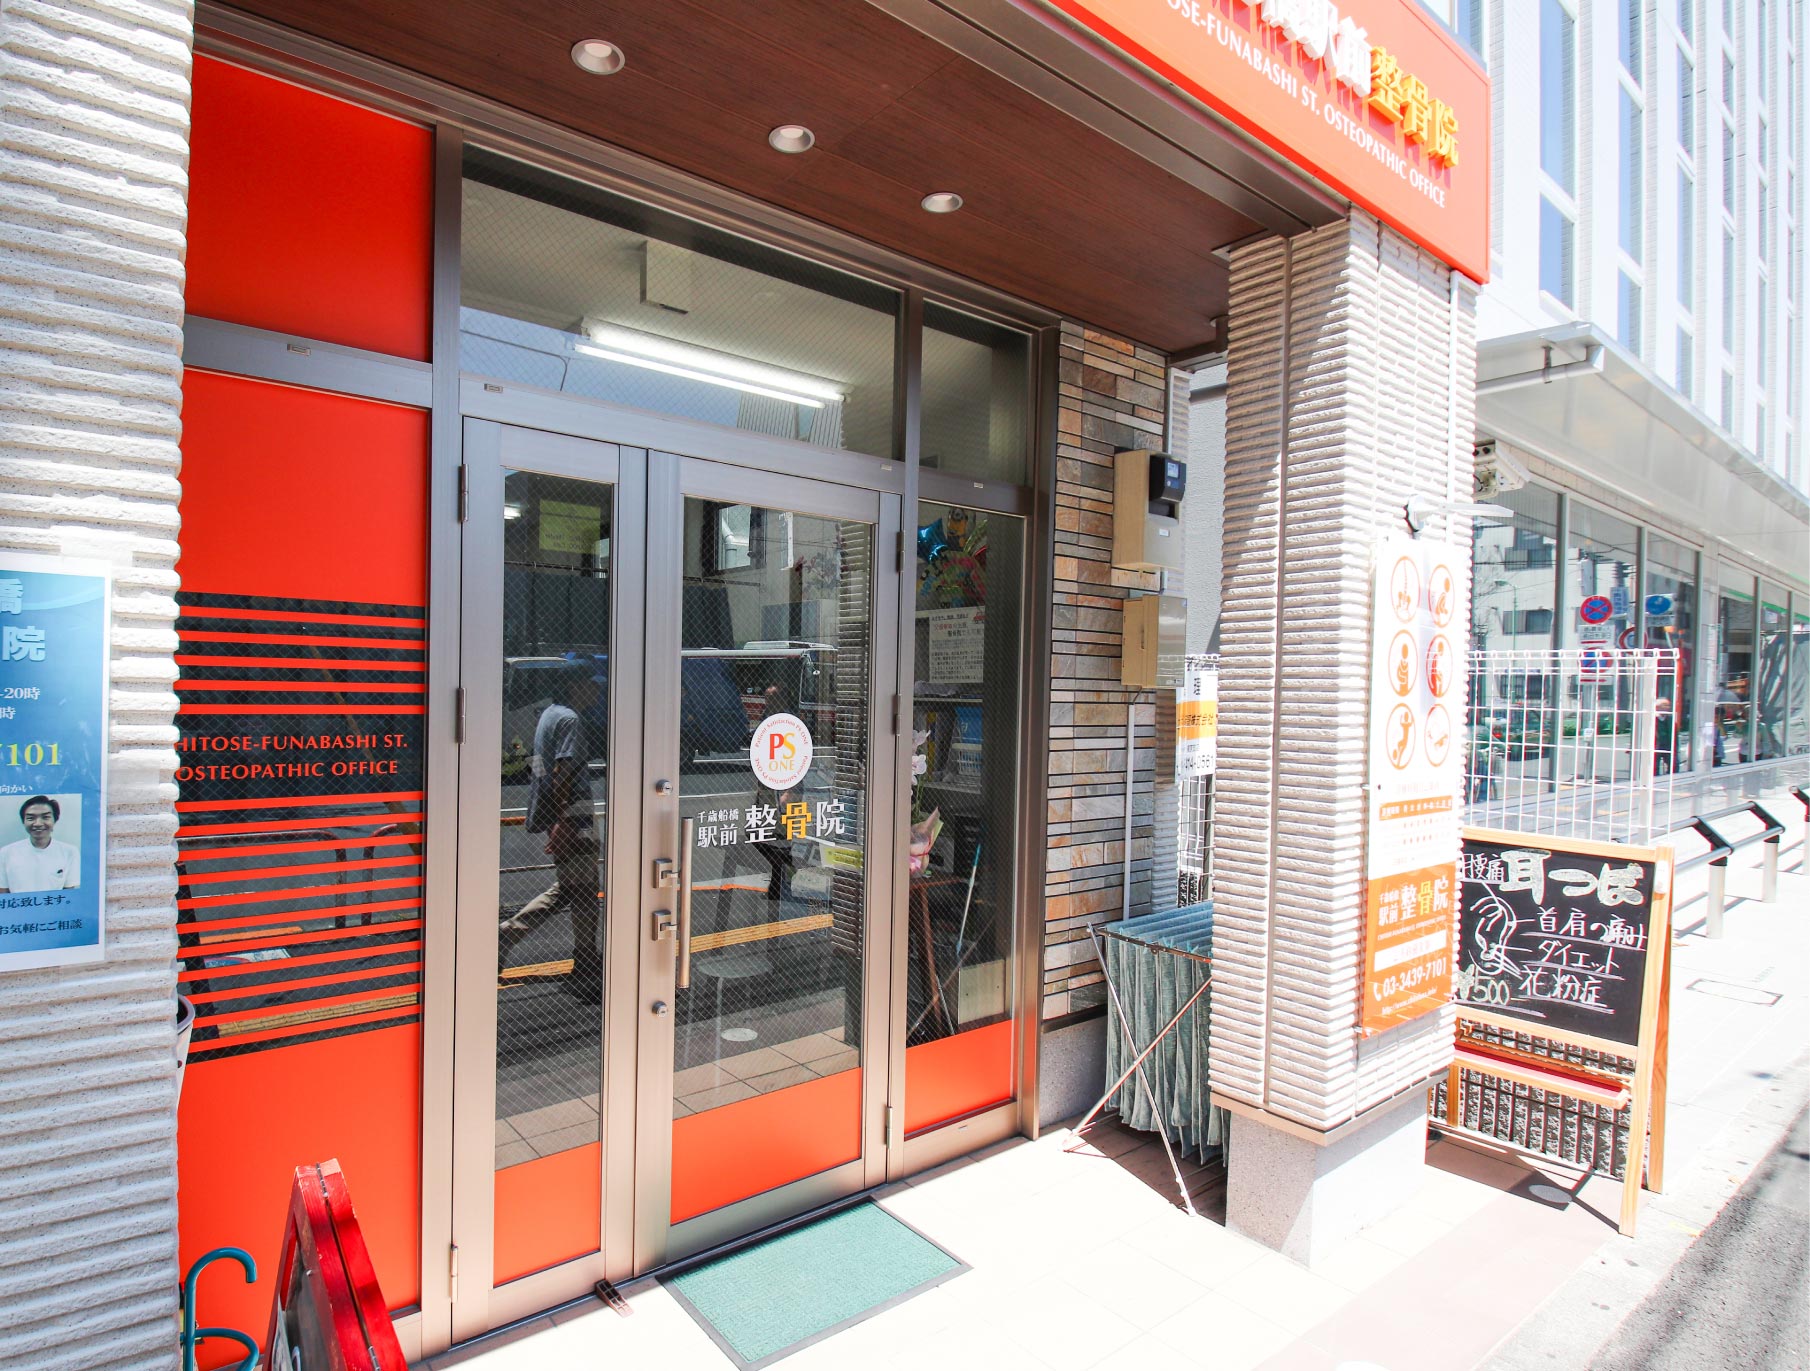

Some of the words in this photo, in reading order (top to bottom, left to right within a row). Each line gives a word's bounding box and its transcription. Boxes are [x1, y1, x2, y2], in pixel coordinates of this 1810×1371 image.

[1302, 86, 1321, 115] ST.
[1324, 104, 1407, 180] OSTEOPATHIC
[1409, 172, 1446, 208] OFFICE
[2, 626, 46, 661] 院
[384, 734, 408, 748] ST.
[769, 732, 796, 760] PS
[174, 763, 324, 781] OSTEOPATHIC
[331, 760, 398, 776] OFFICE
[768, 759, 795, 772] ONE
[697, 808, 739, 823] 千歳船橋
[744, 798, 845, 844] 整骨院
[697, 824, 738, 848] 駅前
[1499, 849, 1645, 906] 耳つぼ
[1538, 940, 1620, 975] ダイエット
[1383, 957, 1447, 997] 03-3439-7101
